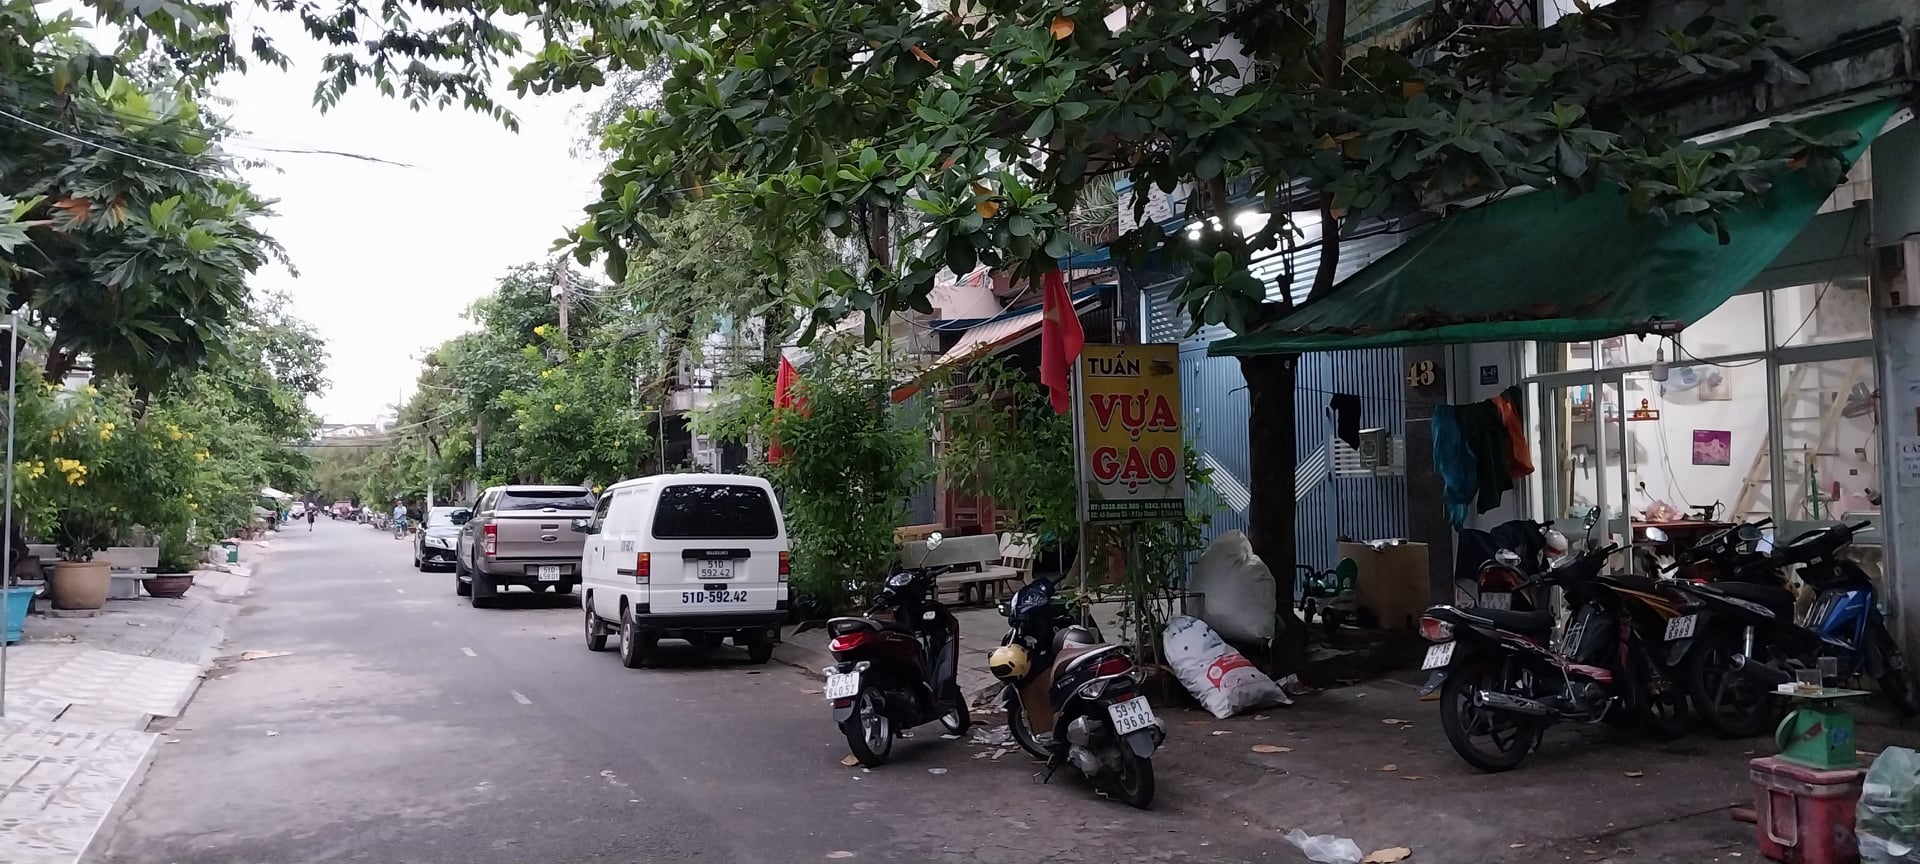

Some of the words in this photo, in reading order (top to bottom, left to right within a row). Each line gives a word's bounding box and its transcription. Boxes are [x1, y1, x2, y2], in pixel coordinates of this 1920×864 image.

[1087, 350, 1141, 376] TUẤN
[1406, 360, 1436, 387] 43
[1089, 388, 1178, 441] VỰA
[1092, 446, 1177, 493] GẠO
[701, 569, 730, 577] 592.42
[707, 560, 724, 568] 51D
[682, 591, 748, 603] 51D-592.42
[1114, 700, 1143, 718] 59-P1
